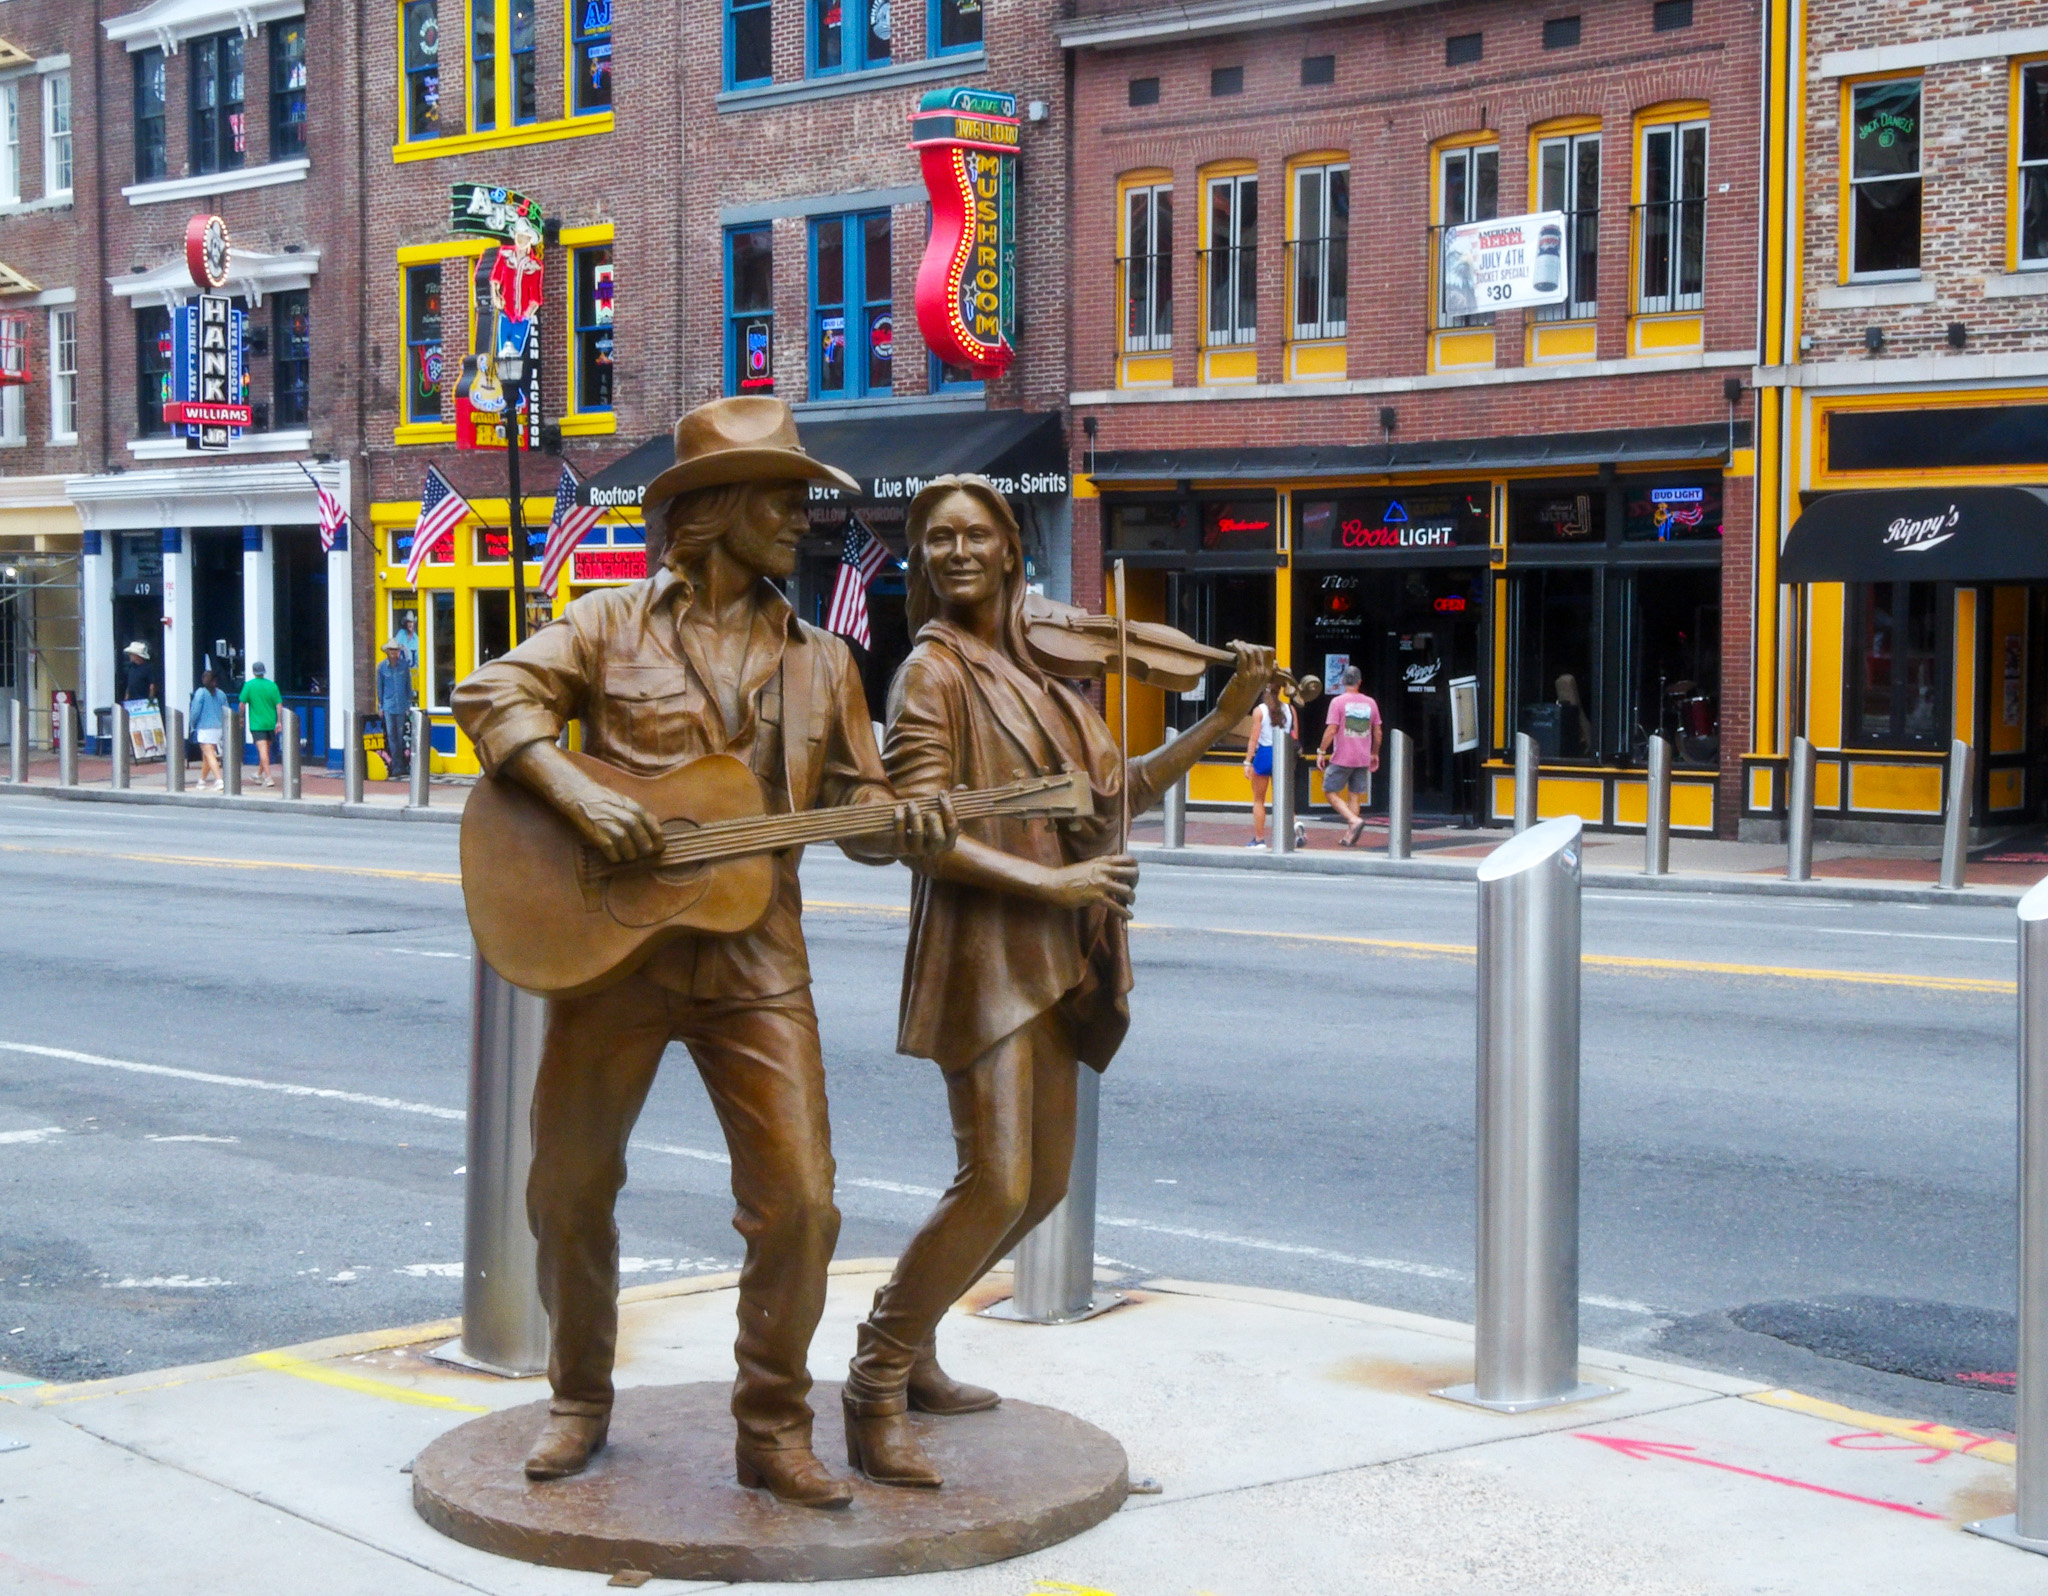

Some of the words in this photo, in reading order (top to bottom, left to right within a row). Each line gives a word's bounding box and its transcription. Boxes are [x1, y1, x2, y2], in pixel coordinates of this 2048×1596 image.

[583, 0, 611, 29] AJ
[955, 118, 1019, 145] MELLOW
[1478, 226, 1522, 239] AMERICAN
[1480, 232, 1525, 250] REBEL
[976, 153, 1000, 336] MUSHROOM
[1479, 251, 1501, 271] JULY
[1504, 248, 1525, 267] 4TH
[1500, 266, 1529, 281] SPECIAL!
[1486, 284, 1513, 301] $30
[231, 321, 239, 346] BAR
[529, 315, 540, 360] ALAN
[203, 299, 227, 401] HANK
[231, 349, 239, 394] BOOGIE
[186, 408, 248, 422] WILLIAMS
[529, 368, 540, 447] JACKSON
[203, 428, 227, 444] JR
[874, 477, 903, 499] Live
[1020, 472, 1067, 494] Spirits
[590, 486, 636, 506] Rooftop
[1654, 490, 1673, 500] BUD
[1674, 489, 1701, 500] LIGHT
[1341, 518, 1400, 549] Coors
[1400, 527, 1454, 547] LIGHT
[1882, 504, 1960, 545] Rippy's
[575, 563, 647, 579] SOMEWHER
[1320, 575, 1358, 589] Tito's
[134, 583, 151, 595] 419
[1434, 598, 1466, 612] OPEN
[1402, 657, 1442, 682] Rippy's
